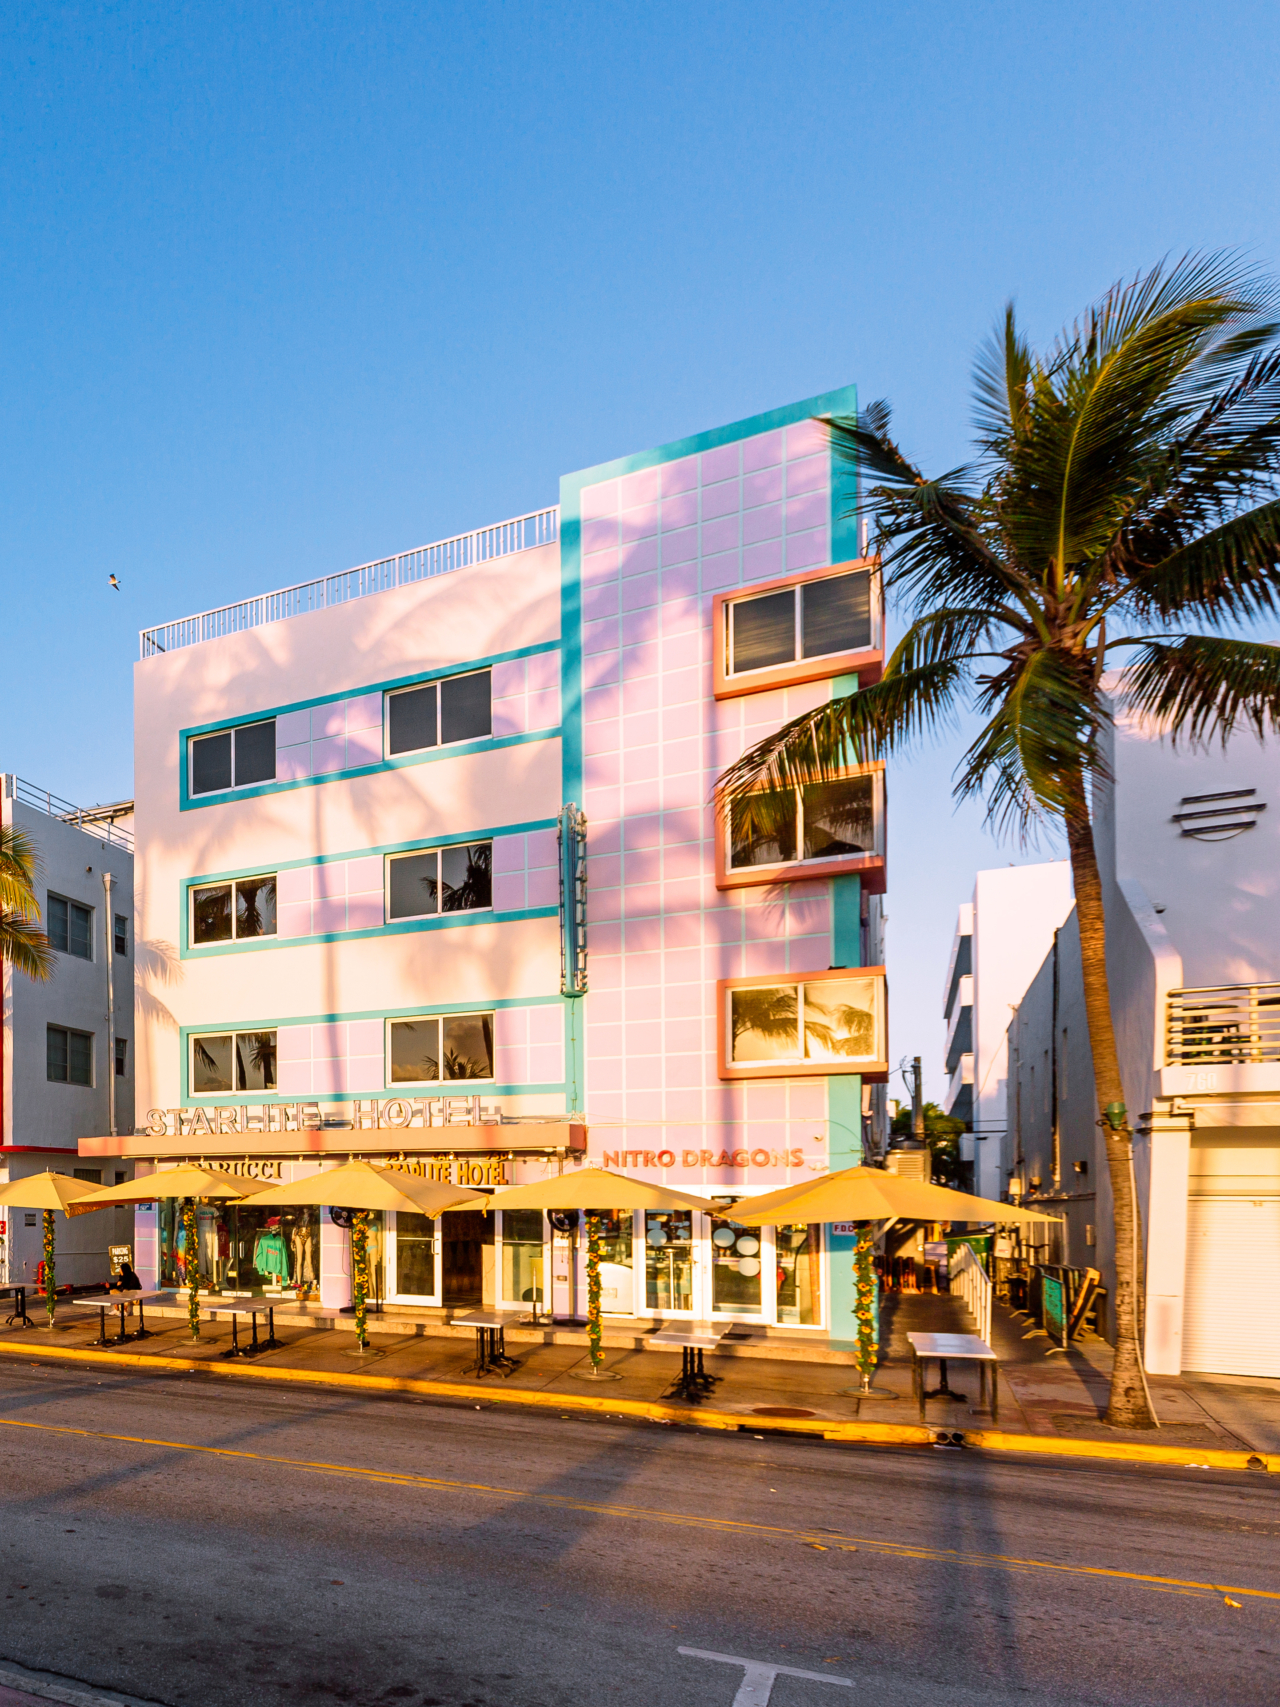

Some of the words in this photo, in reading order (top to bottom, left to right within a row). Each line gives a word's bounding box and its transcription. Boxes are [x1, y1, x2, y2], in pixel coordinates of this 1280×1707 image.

[1186, 1073, 1216, 1091] 760
[145, 1101, 320, 1137] STARLITE
[353, 1095, 497, 1130] HOTEL
[602, 1150, 676, 1168] NITRO
[681, 1148, 805, 1168] DRAGONS
[456, 1162, 509, 1186] HOTEL
